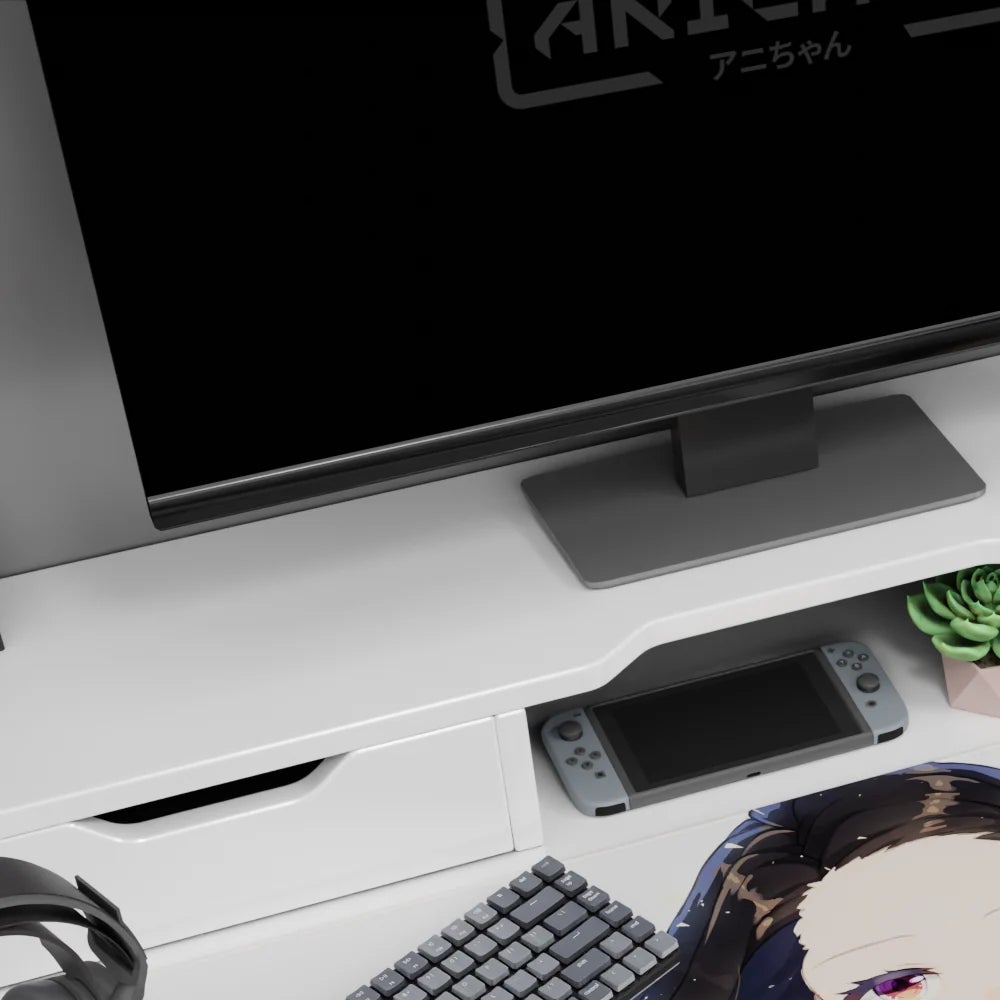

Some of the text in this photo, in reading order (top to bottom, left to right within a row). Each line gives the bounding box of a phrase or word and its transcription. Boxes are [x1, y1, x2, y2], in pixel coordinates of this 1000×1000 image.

[709, 30, 852, 81] アニちゃん
